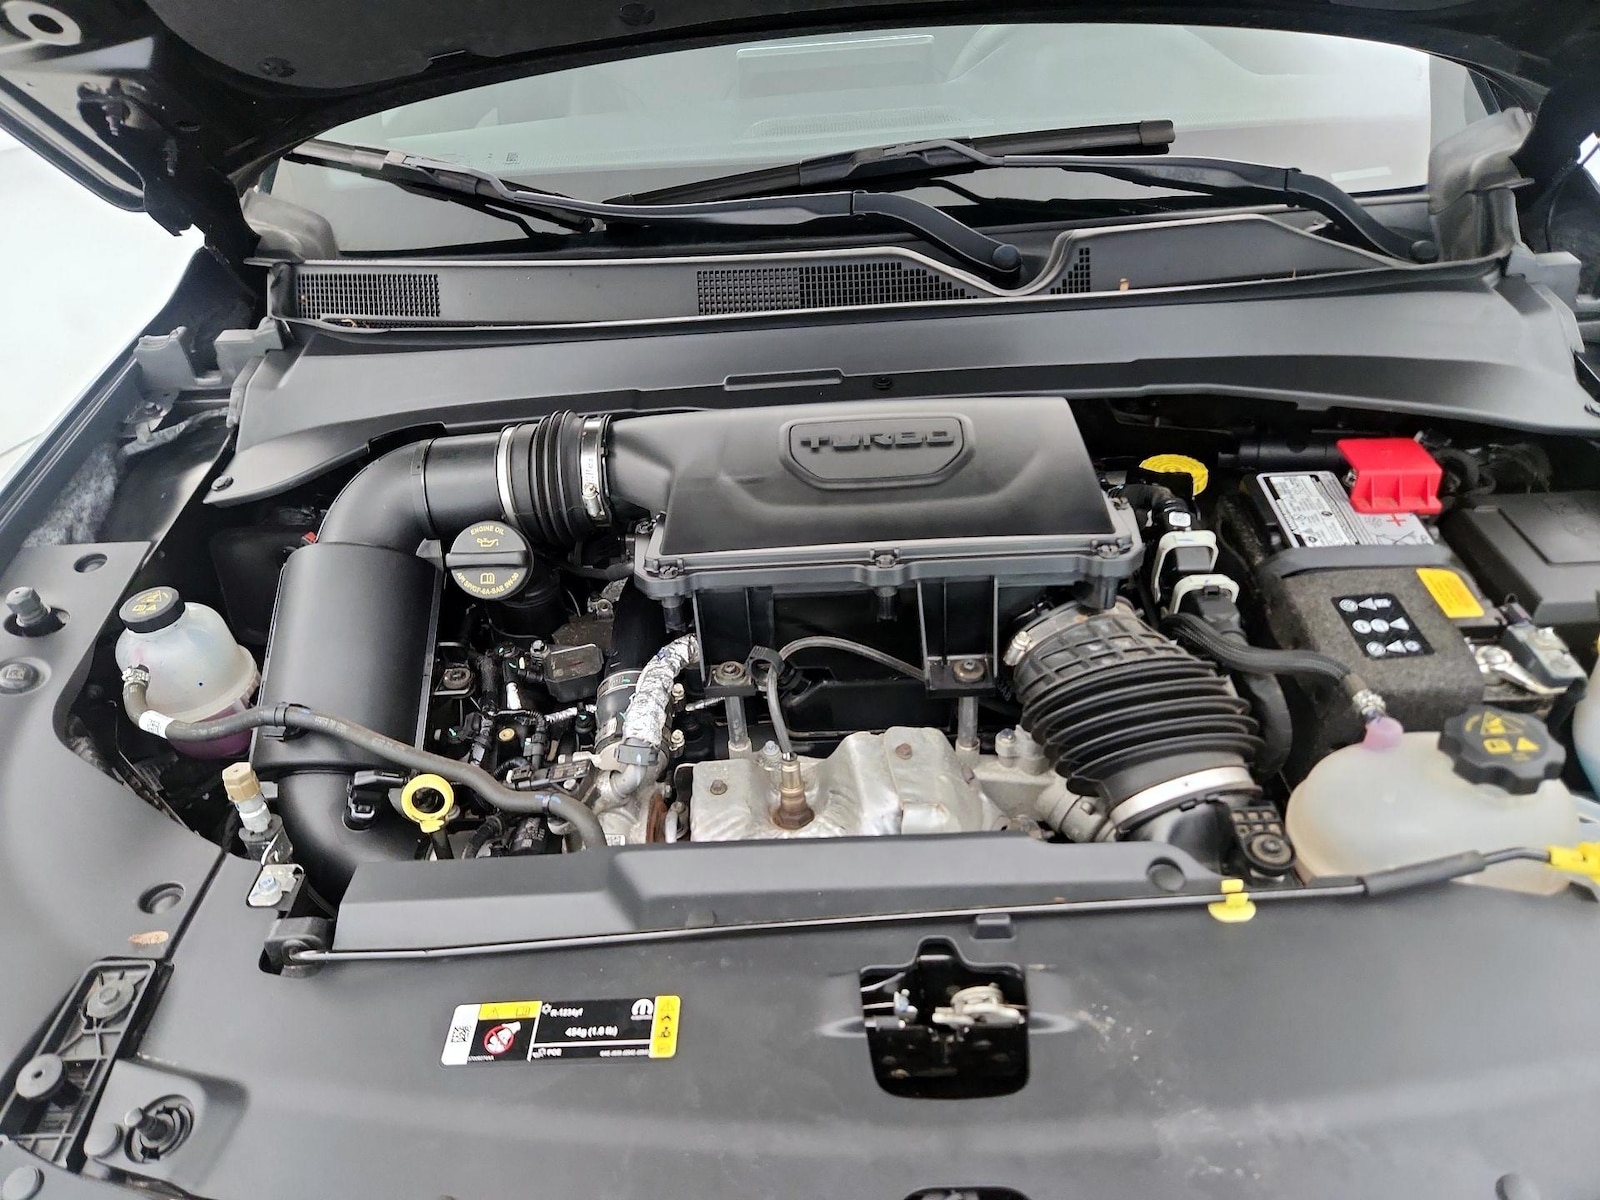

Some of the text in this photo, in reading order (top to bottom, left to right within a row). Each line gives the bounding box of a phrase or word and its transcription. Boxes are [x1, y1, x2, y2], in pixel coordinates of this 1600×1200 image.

[800, 430, 955, 453] TURBO
[470, 525, 505, 536] ENGINE OIL
